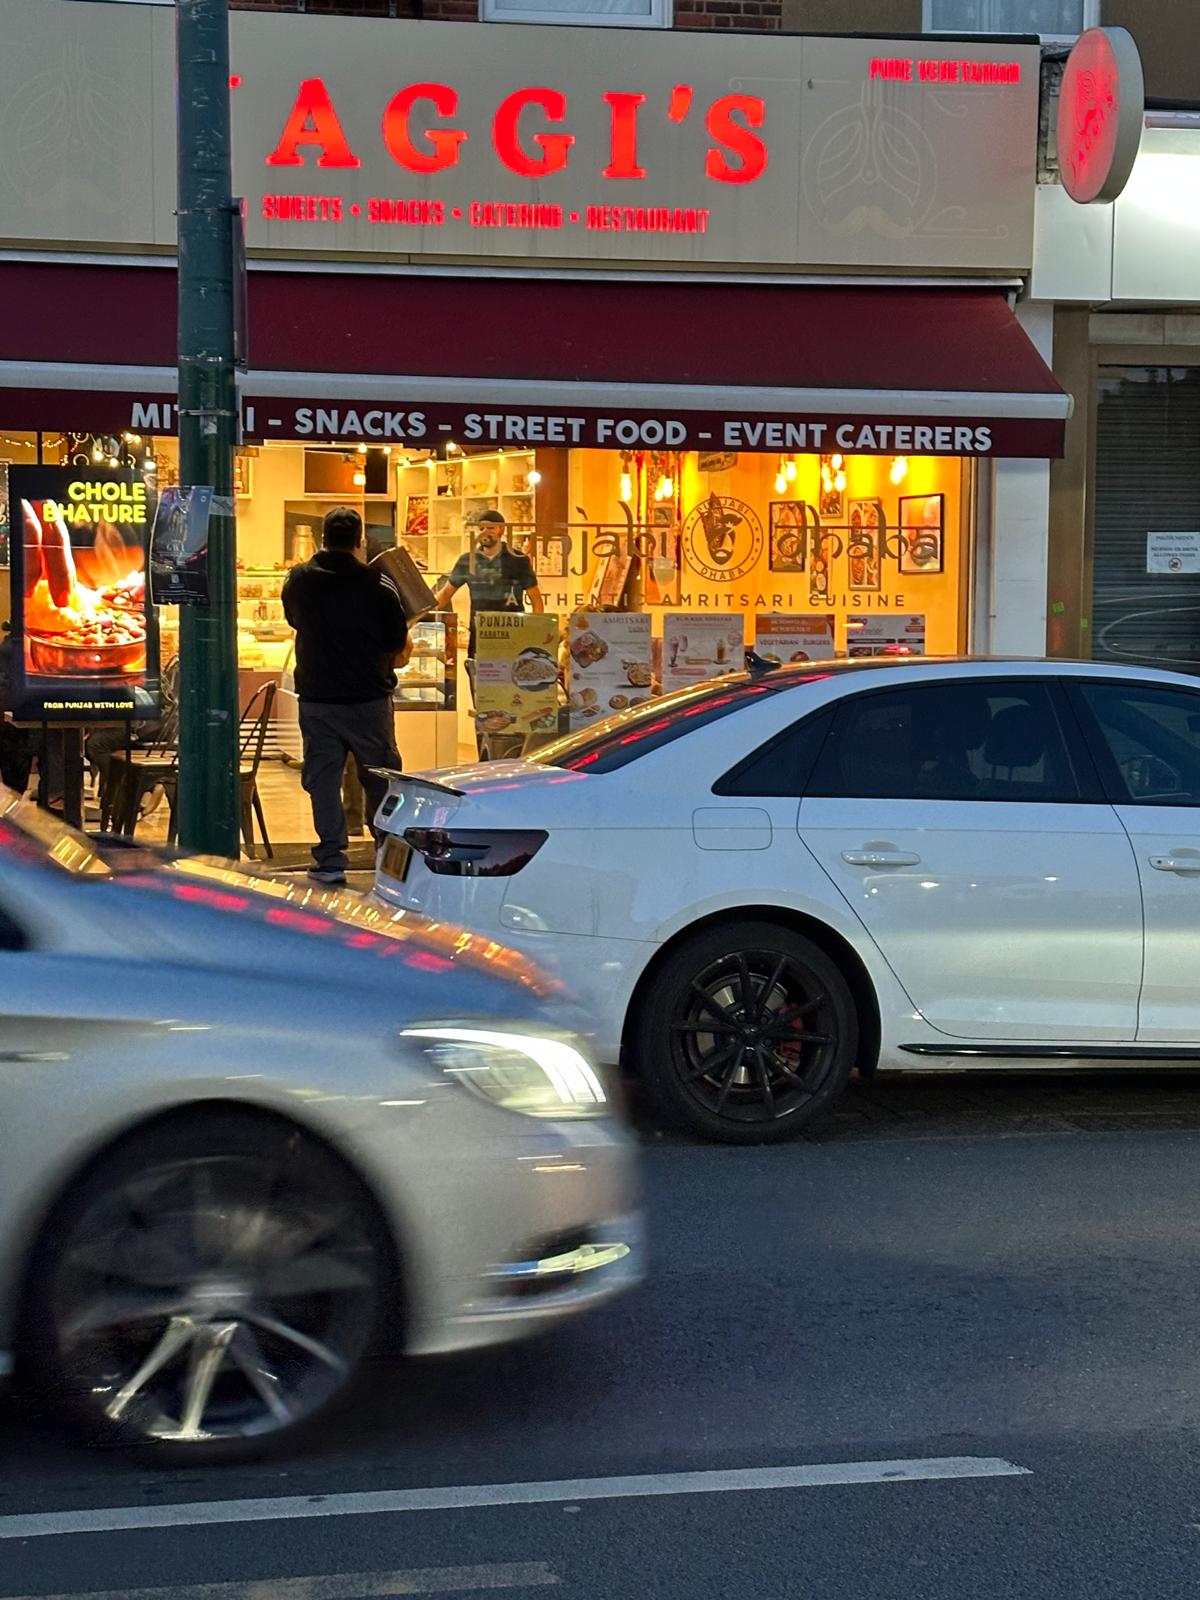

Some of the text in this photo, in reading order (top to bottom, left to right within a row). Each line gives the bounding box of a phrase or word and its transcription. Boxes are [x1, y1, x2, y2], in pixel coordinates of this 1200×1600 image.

[870, 58, 1020, 84] PURE VEGETARIAN
[229, 76, 768, 185] AGGI'S
[262, 193, 709, 233] SWEETS SNACKS CATERING RESTAURANT
[131, 402, 255, 432] MII
[295, 407, 427, 437] SNACKS
[463, 413, 586, 443] STREET
[596, 418, 687, 445] FOOD
[723, 421, 828, 447] EVENT
[835, 424, 992, 452] CATERERS
[68, 481, 147, 501] CHOLE
[43, 502, 147, 523] BHATURE
[695, 498, 750, 515] PUJABI
[701, 566, 745, 581] DHABA
[662, 594, 793, 607] AMRITSARI
[808, 594, 905, 607] CUISINE
[480, 615, 524, 628] PUNJABI
